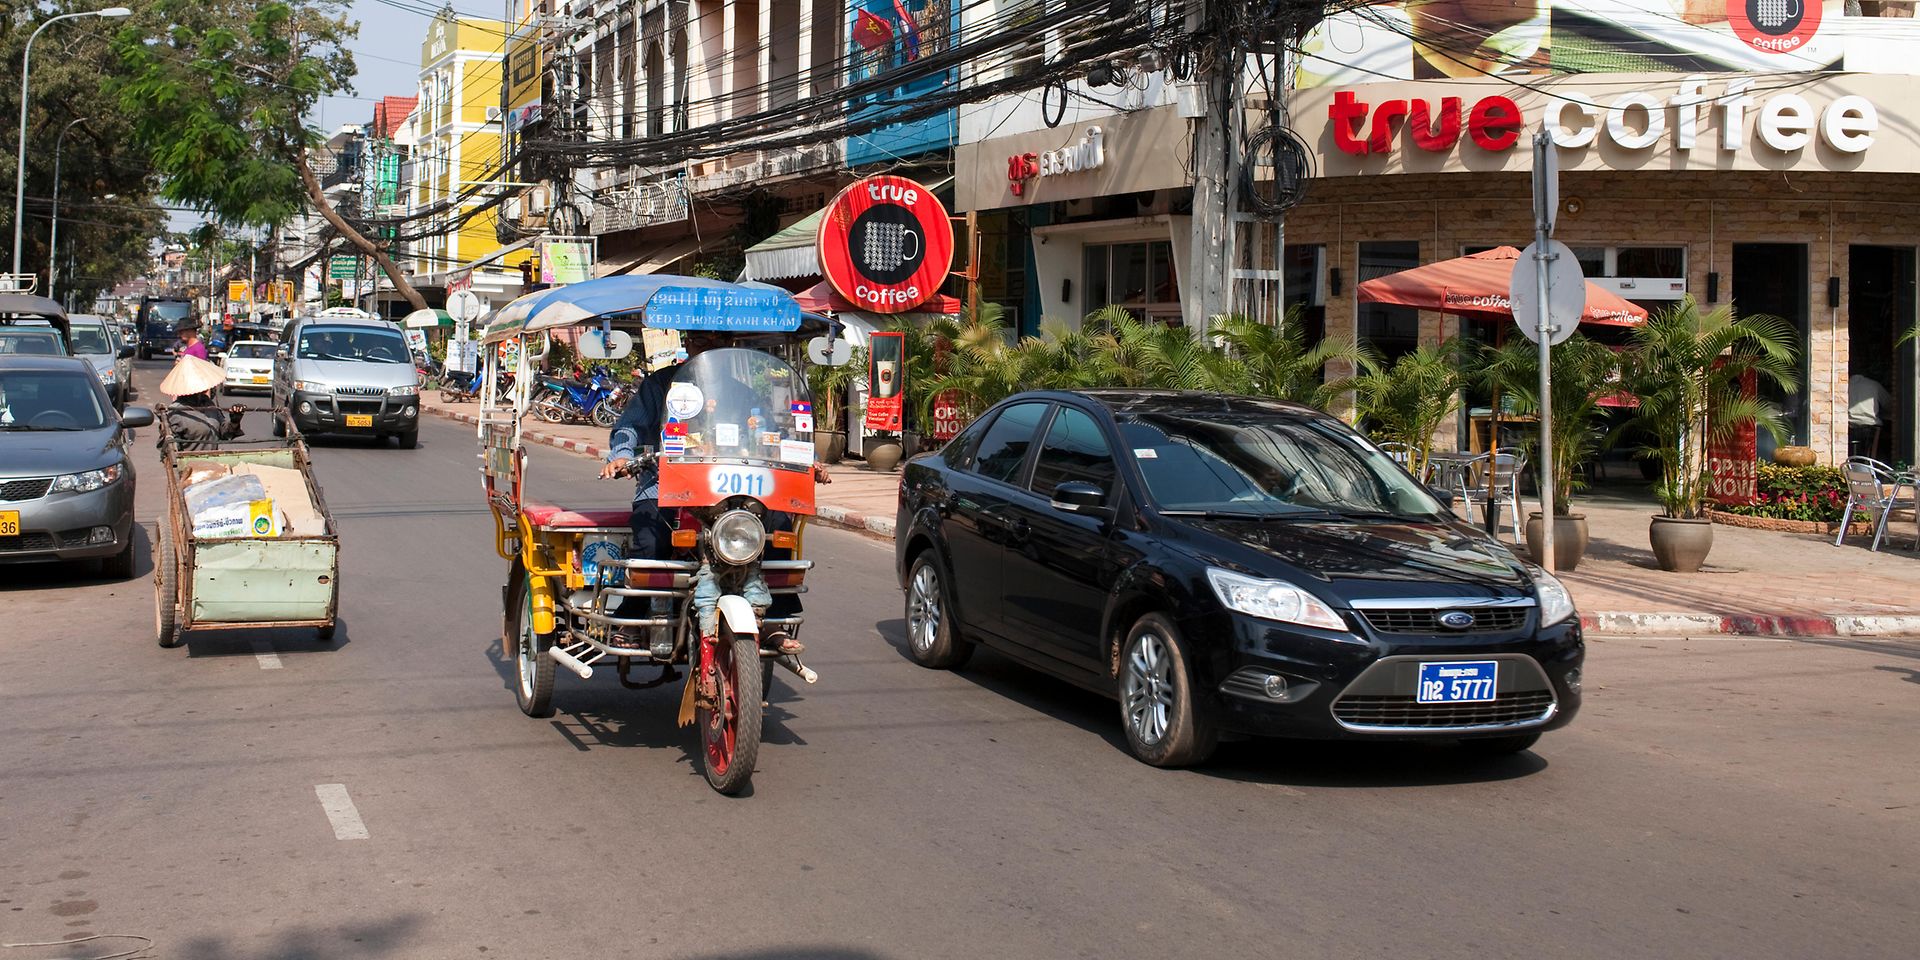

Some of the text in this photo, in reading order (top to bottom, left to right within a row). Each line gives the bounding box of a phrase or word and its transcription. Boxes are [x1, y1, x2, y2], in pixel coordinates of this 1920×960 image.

[1752, 36, 1801, 51] coffee
[1328, 79, 1879, 156] true coffee
[868, 183, 918, 206] true
[855, 285, 919, 305] coffee
[1446, 291, 1472, 305] true
[648, 314, 796, 327] KED 3 THONG KANH KHAM
[1709, 458, 1755, 477] OPEN
[717, 472, 764, 496] 2011
[1450, 679, 1493, 699] 5777
